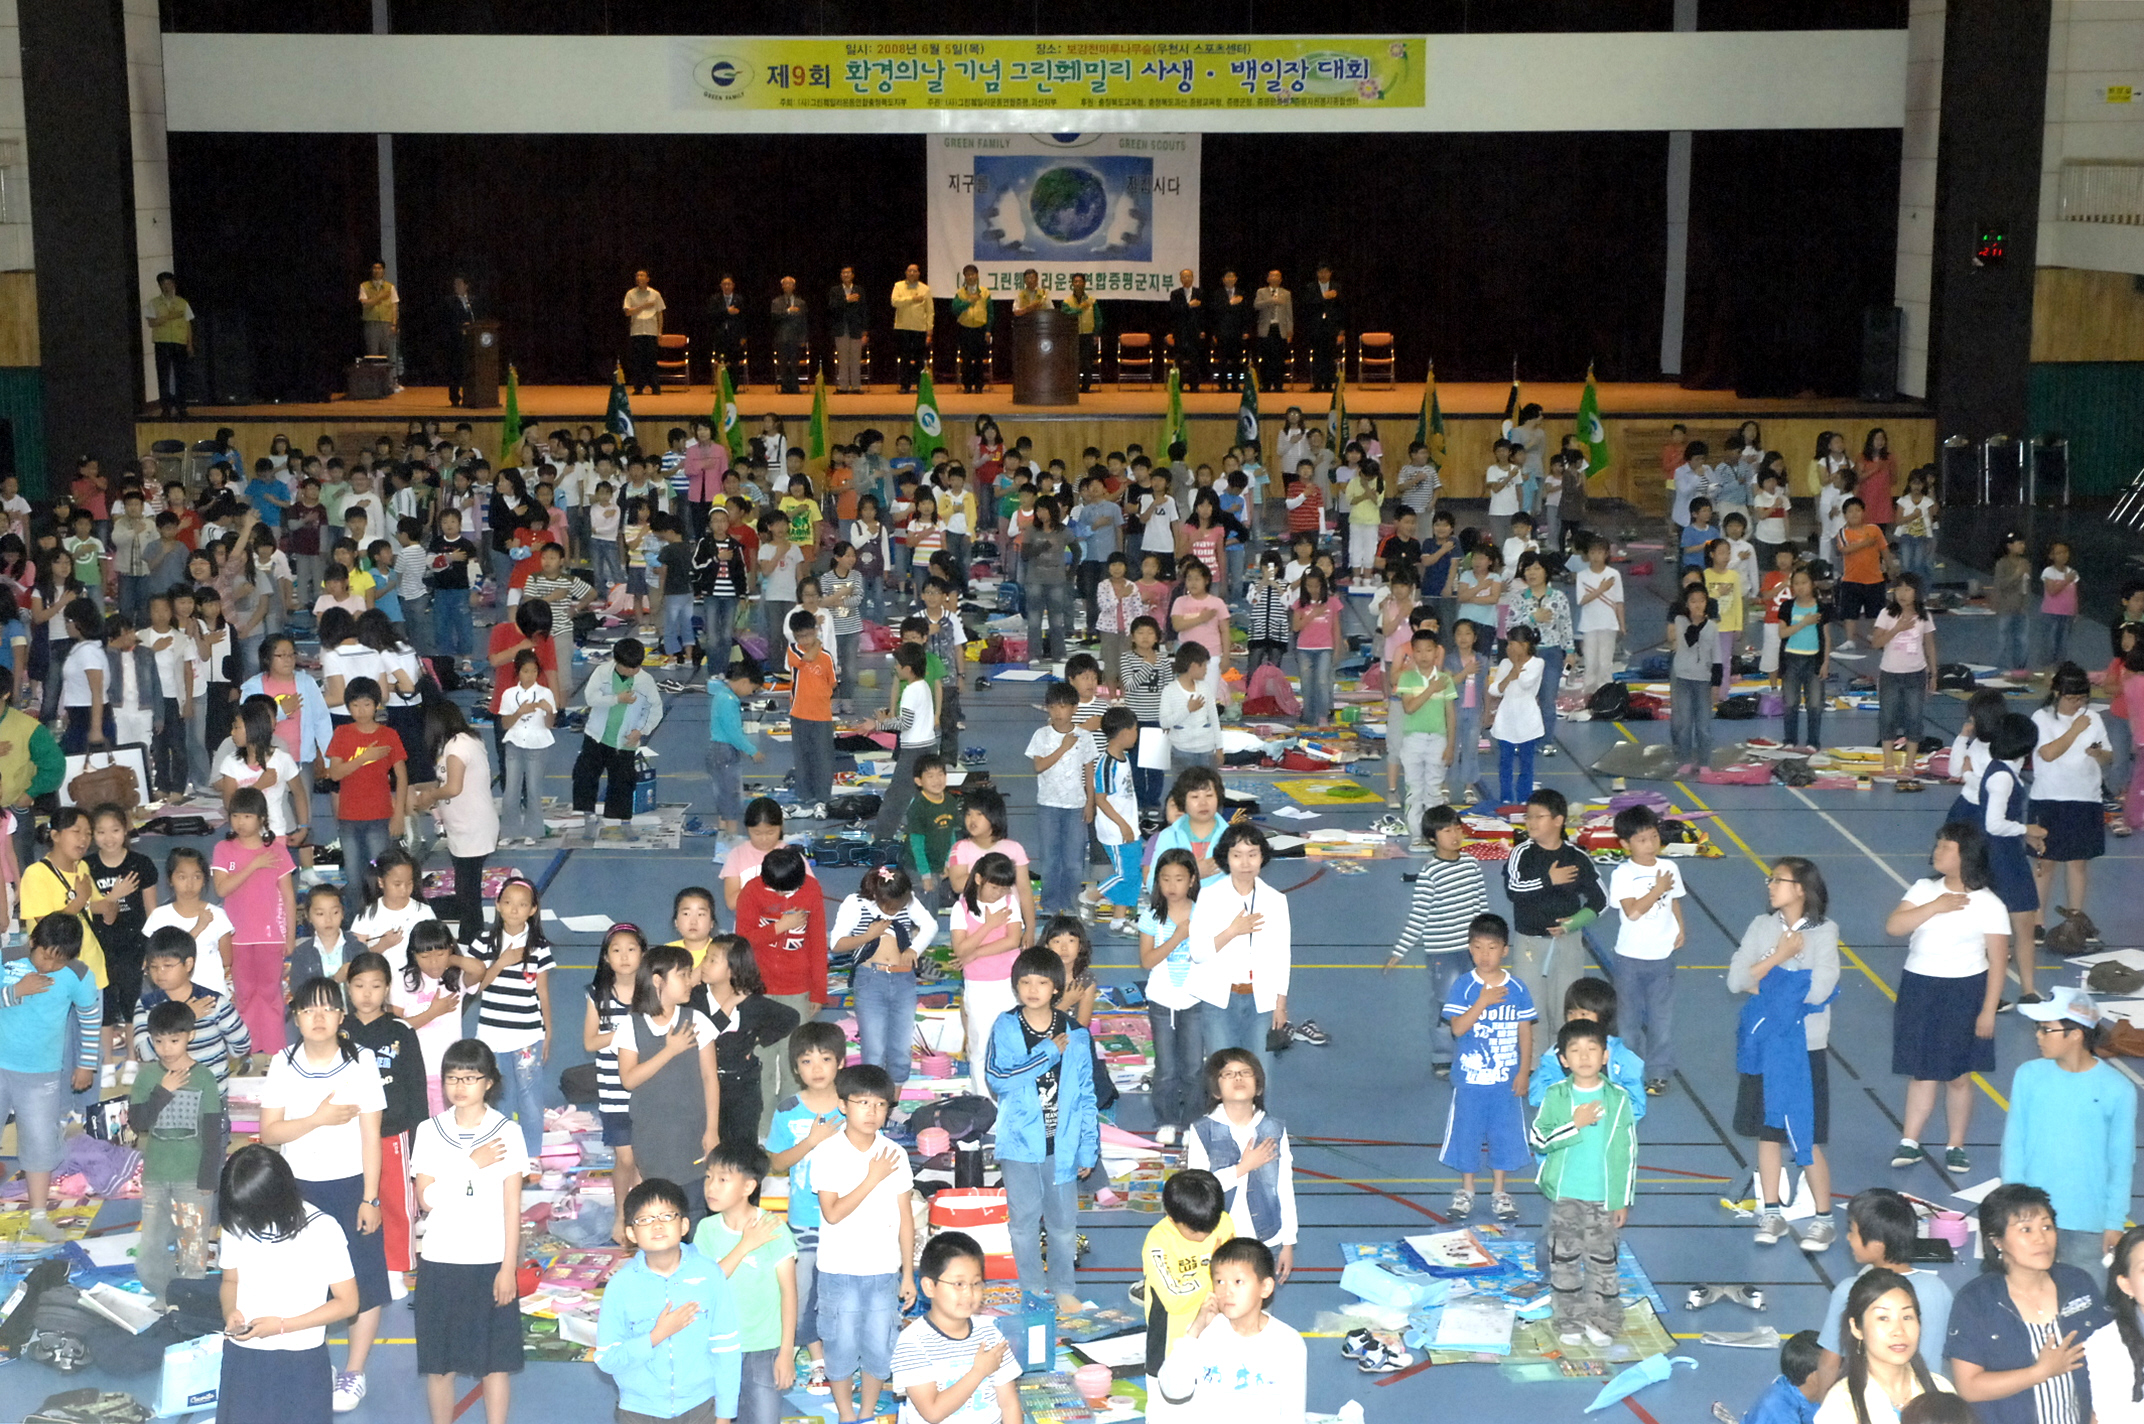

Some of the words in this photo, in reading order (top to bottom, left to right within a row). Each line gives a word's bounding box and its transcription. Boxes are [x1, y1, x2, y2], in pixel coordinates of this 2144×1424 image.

[846, 43, 872, 55] 일시:
[877, 43, 917, 55] 2008년
[921, 43, 940, 55] 6월
[944, 43, 985, 55] 5일(목)
[1036, 43, 1062, 55] 장소:
[767, 64, 831, 89] 제9회
[844, 58, 947, 94] 환경의날
[954, 59, 1002, 94] 기념
[1141, 58, 1194, 94] 사생
[1230, 58, 1309, 94] 백일장
[1317, 58, 1370, 81] 대회
[944, 137, 974, 148] GREEN
[977, 138, 1011, 149] FAMILY
[1119, 138, 1148, 150] GREEN
[1150, 139, 1187, 151] SCOUTS
